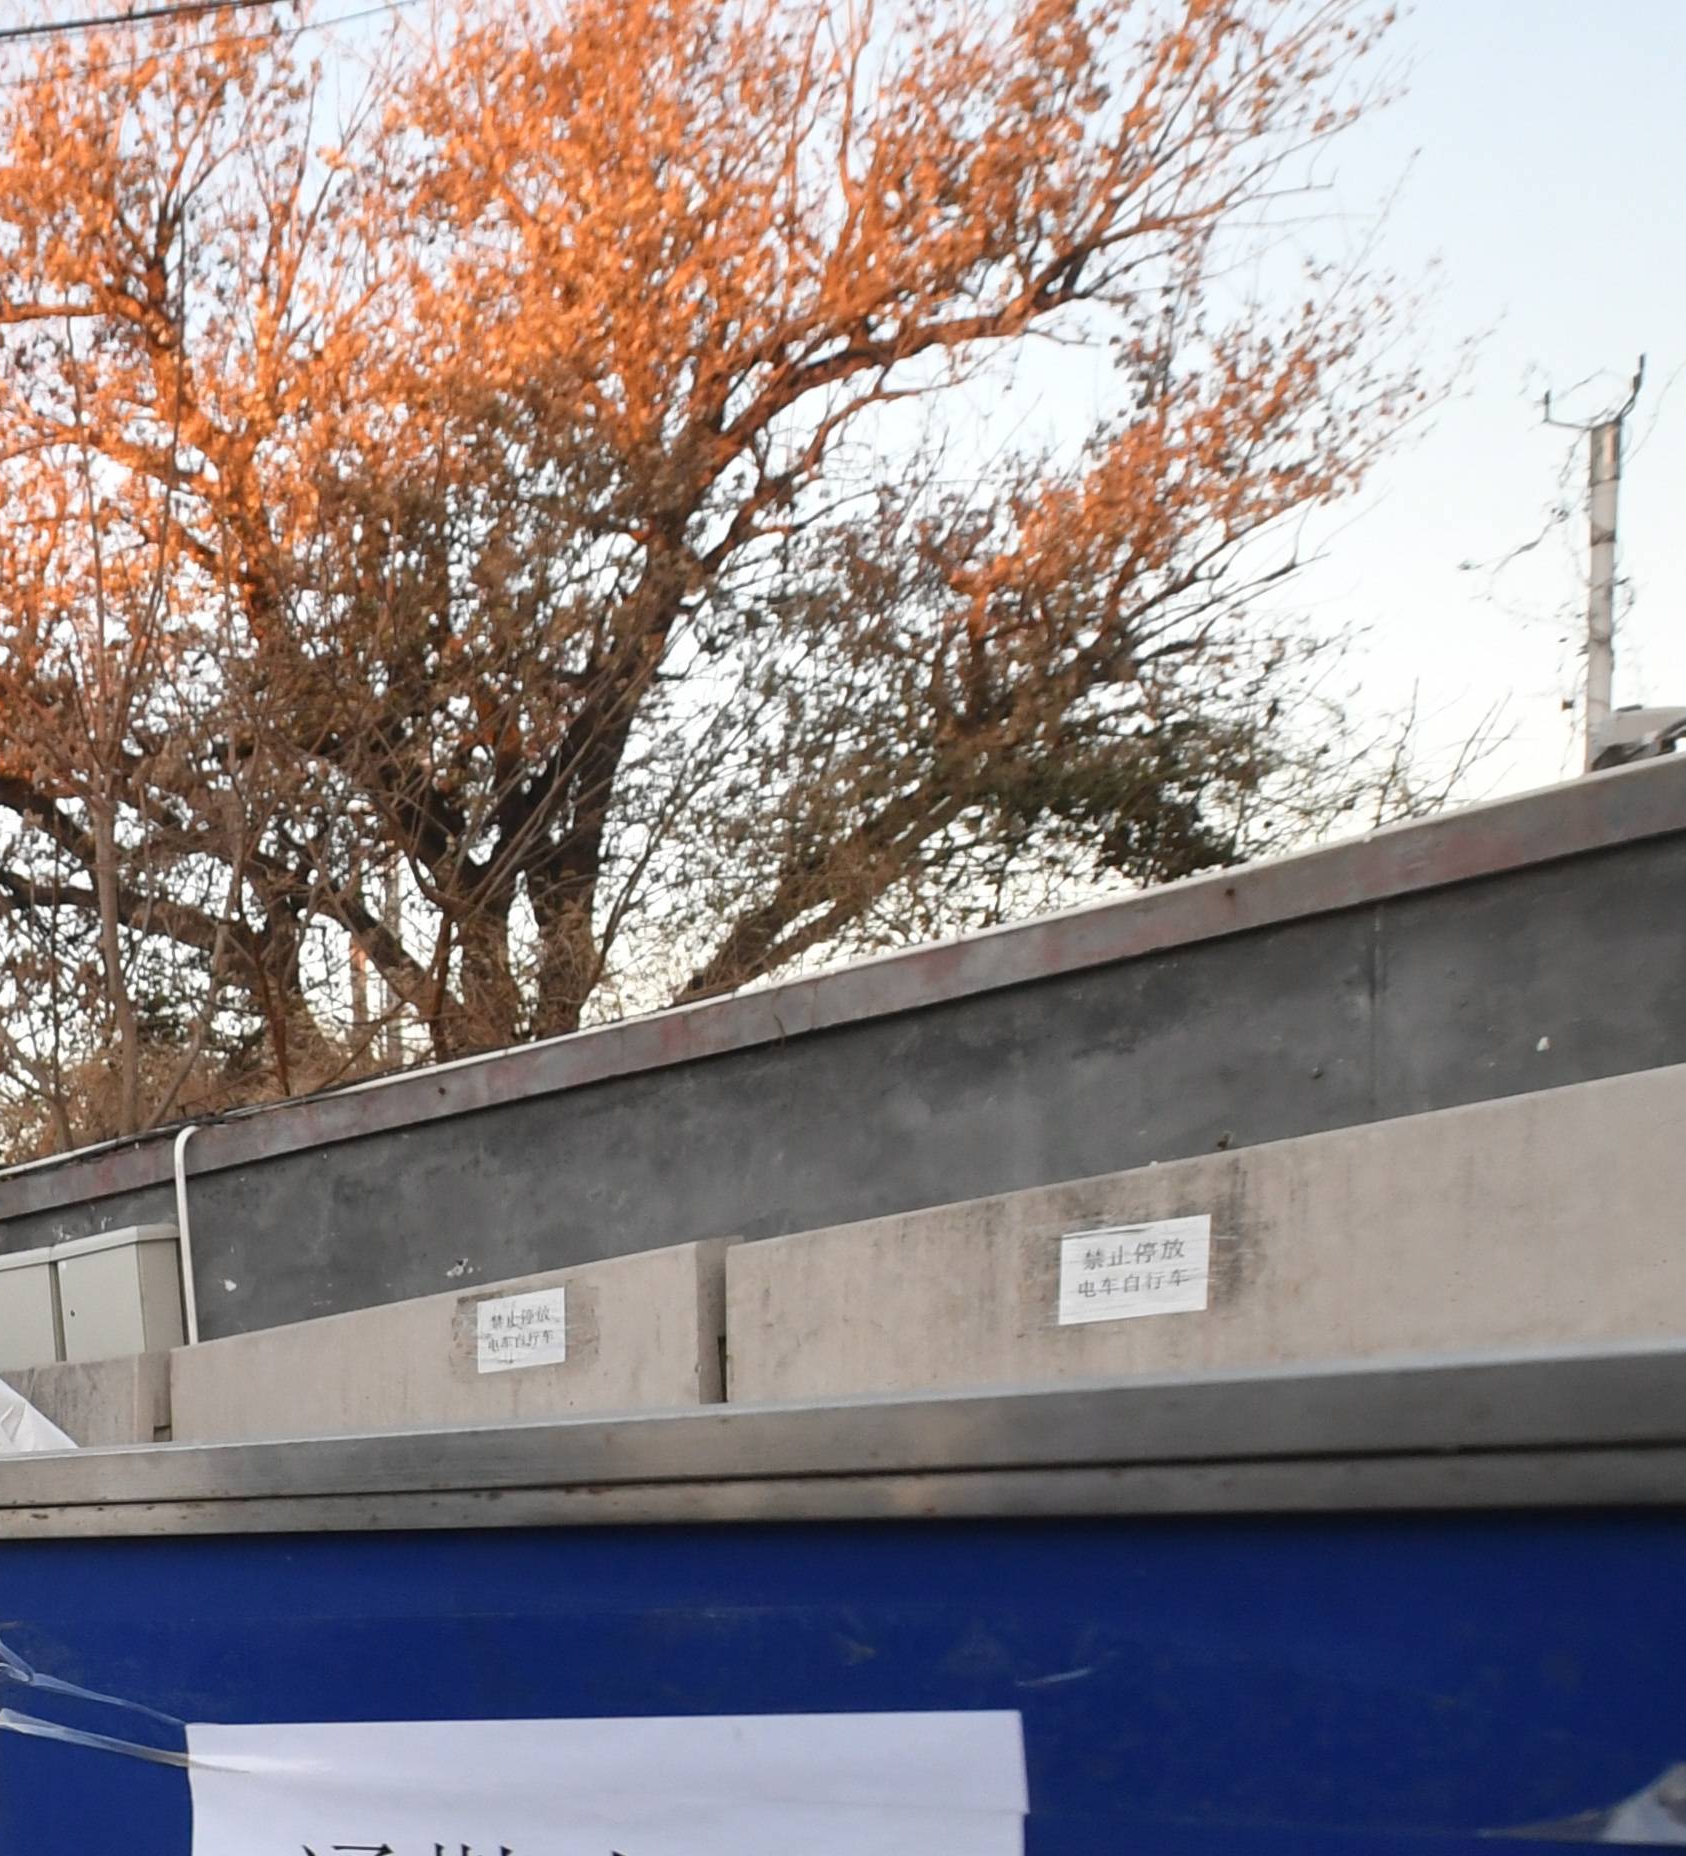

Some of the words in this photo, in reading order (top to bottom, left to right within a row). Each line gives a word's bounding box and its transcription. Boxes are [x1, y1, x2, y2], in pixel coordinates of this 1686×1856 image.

[1083, 1238, 1186, 1271] 禁止停放
[1078, 1268, 1190, 1298] 电车自行车
